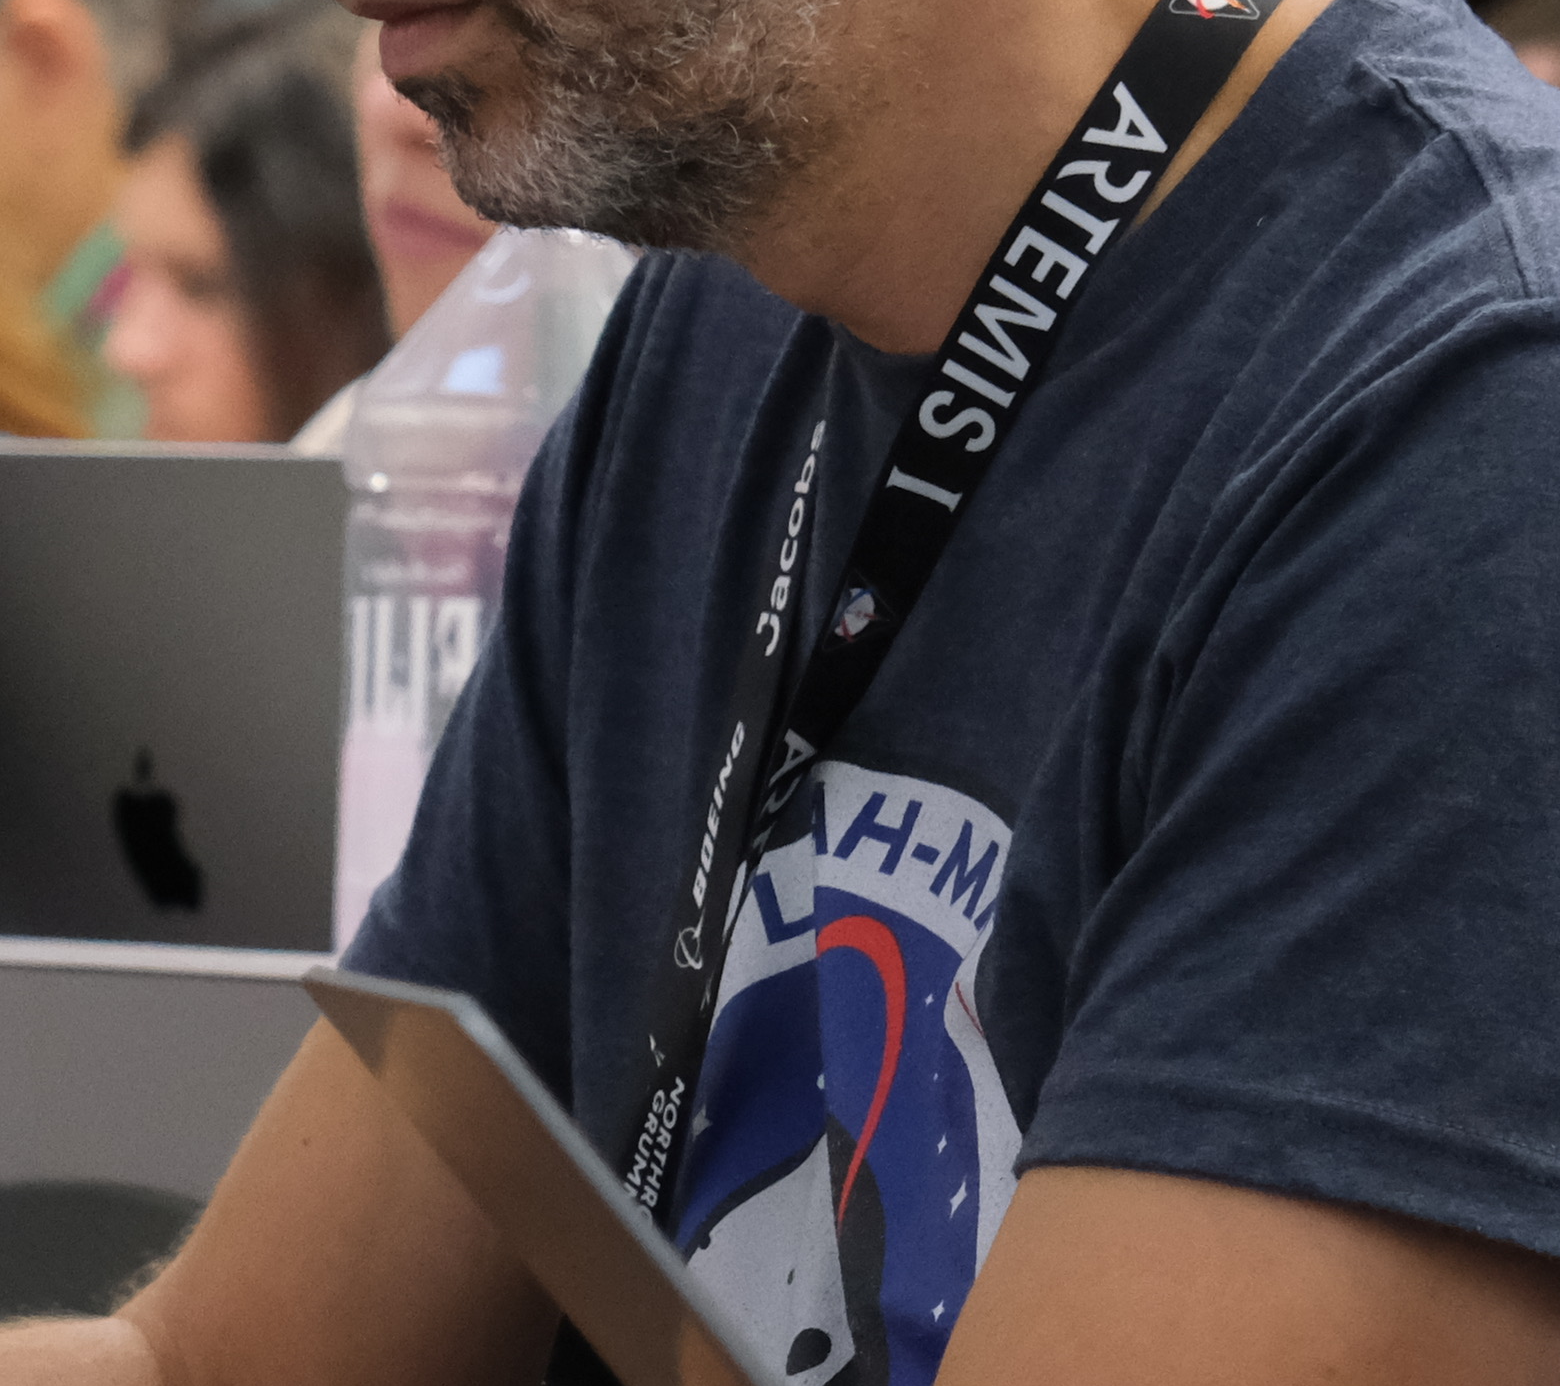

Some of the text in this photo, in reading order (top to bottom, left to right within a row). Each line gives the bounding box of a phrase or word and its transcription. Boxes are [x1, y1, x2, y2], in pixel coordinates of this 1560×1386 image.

[885, 81, 1168, 513] ARTEMIS I
[756, 420, 826, 657] Jacobs
[692, 720, 746, 907] BOEING
